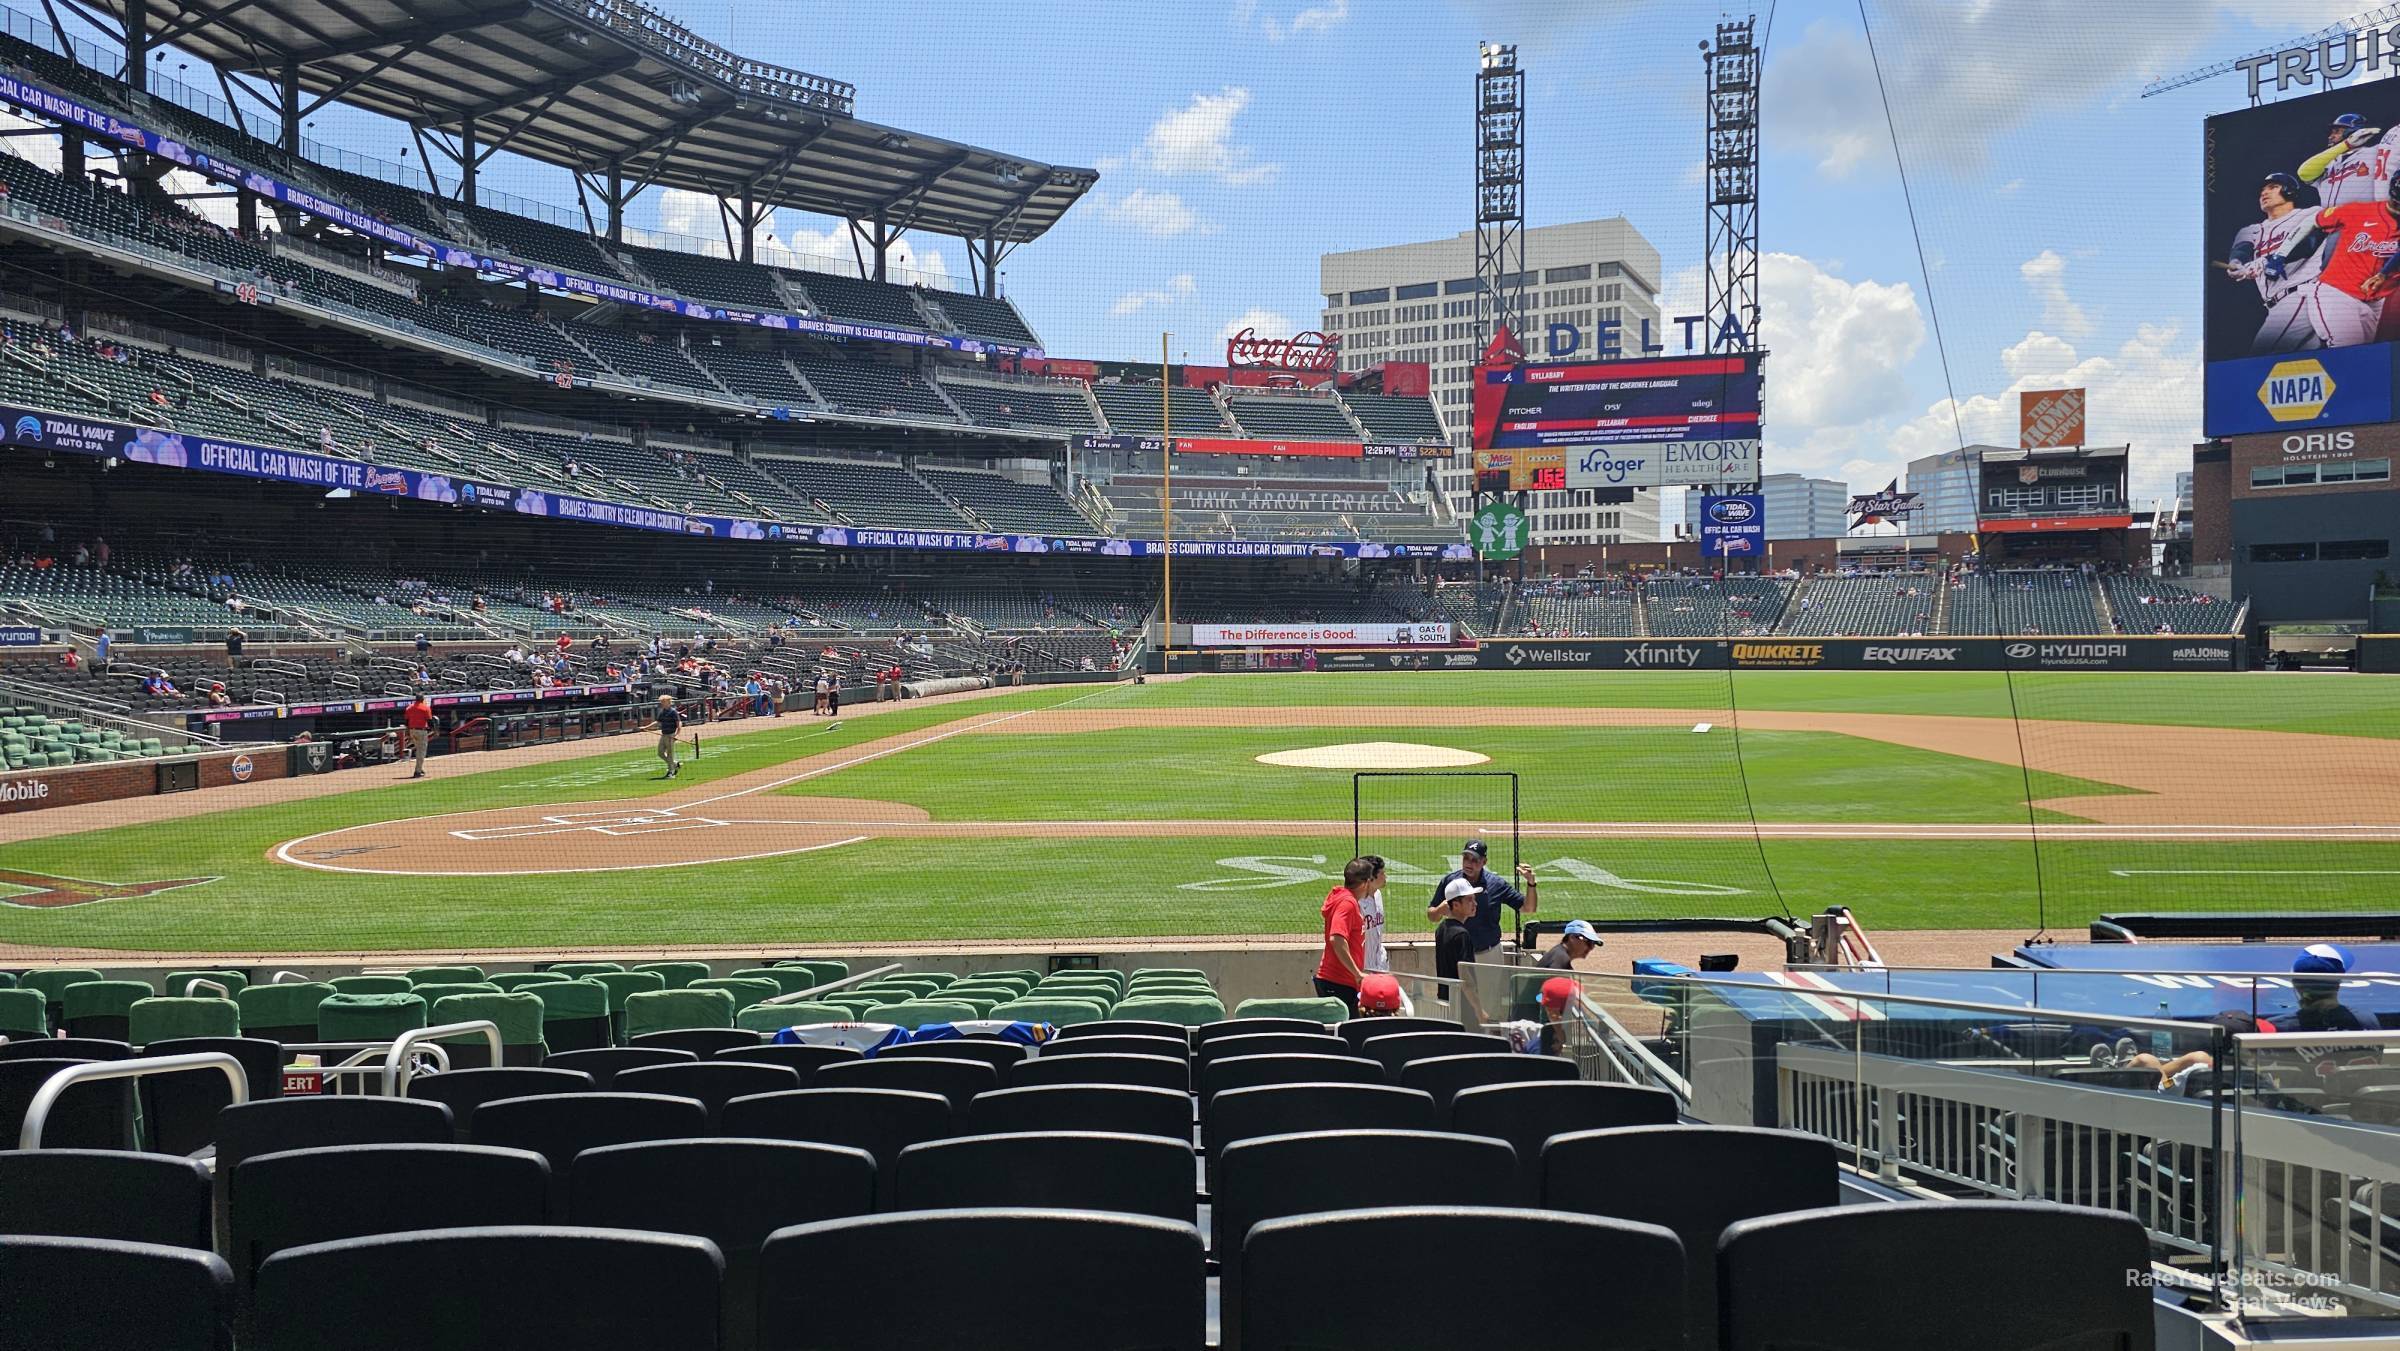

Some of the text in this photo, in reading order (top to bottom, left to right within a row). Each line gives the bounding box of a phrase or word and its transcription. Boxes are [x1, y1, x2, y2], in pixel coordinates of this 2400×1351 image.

[22, 86, 42, 107] CAR
[44, 94, 72, 119] WASH
[74, 106, 86, 123] OF
[88, 111, 106, 131] THE
[287, 188, 412, 247] BRAVES COUNTRY IS CLEAN CAR COUNTRY
[236, 282, 258, 306] 44
[566, 276, 650, 305] OFFICIAL CAR WASH OF THE
[798, 319, 925, 344] BRAVES COUNTRY IS CLEAN CAR COUNTRY
[1549, 313, 1748, 357] DELTA
[555, 372, 573, 389] 47
[1531, 371, 1565, 380] SYLLABARY
[2271, 376, 2323, 405] NAPA
[1508, 407, 1542, 415] PITCHER
[2022, 389, 2084, 448] HOME
[2026, 397, 2053, 420] THE
[45, 420, 115, 442] TIDAL WAVE
[2048, 410, 2084, 446] DEPOT
[56, 437, 103, 451] AUTO SPA
[1364, 446, 1396, 455] 12:26 PM
[1666, 441, 1753, 462] EMORY
[2282, 431, 2355, 454] ORIS
[201, 443, 258, 472] OFFICIAL
[261, 452, 285, 476] CAR
[288, 456, 322, 481] WASH
[324, 462, 338, 484] OF
[341, 464, 362, 486] THE
[1580, 448, 1645, 483] Kroger
[1538, 468, 1565, 483] 162
[476, 486, 494, 498] TIDAL
[1183, 490, 1402, 512] HANK AARON TERRACE
[559, 498, 683, 531] BRAVES COUNTRY IS CLEAN CAR COUNTRY
[1865, 499, 1890, 513] Star
[1889, 499, 1925, 513] Game
[857, 531, 896, 545] OFFICIAL
[897, 533, 916, 546] CAR
[916, 534, 942, 547] WASH
[944, 535, 955, 547] OF
[956, 535, 972, 548] THE
[1704, 526, 1729, 534] OFFICAL
[1179, 543, 1216, 554] COUNTRY
[1217, 543, 1225, 554] IS
[1227, 543, 1253, 555] CLEAN
[1254, 544, 1270, 555] CAR
[1272, 544, 1307, 555] COUNTRY
[1220, 629, 1357, 640] The Difference is Good.
[1528, 650, 1592, 662] Wellstar
[1624, 643, 1701, 666] xfinity
[1732, 644, 1823, 660] QUIKRETE
[1863, 646, 1958, 664] EQUIFAX
[2041, 645, 2126, 657] HYUNDAI
[234, 763, 252, 773] Gulf
[0, 779, 48, 802] Mobile
